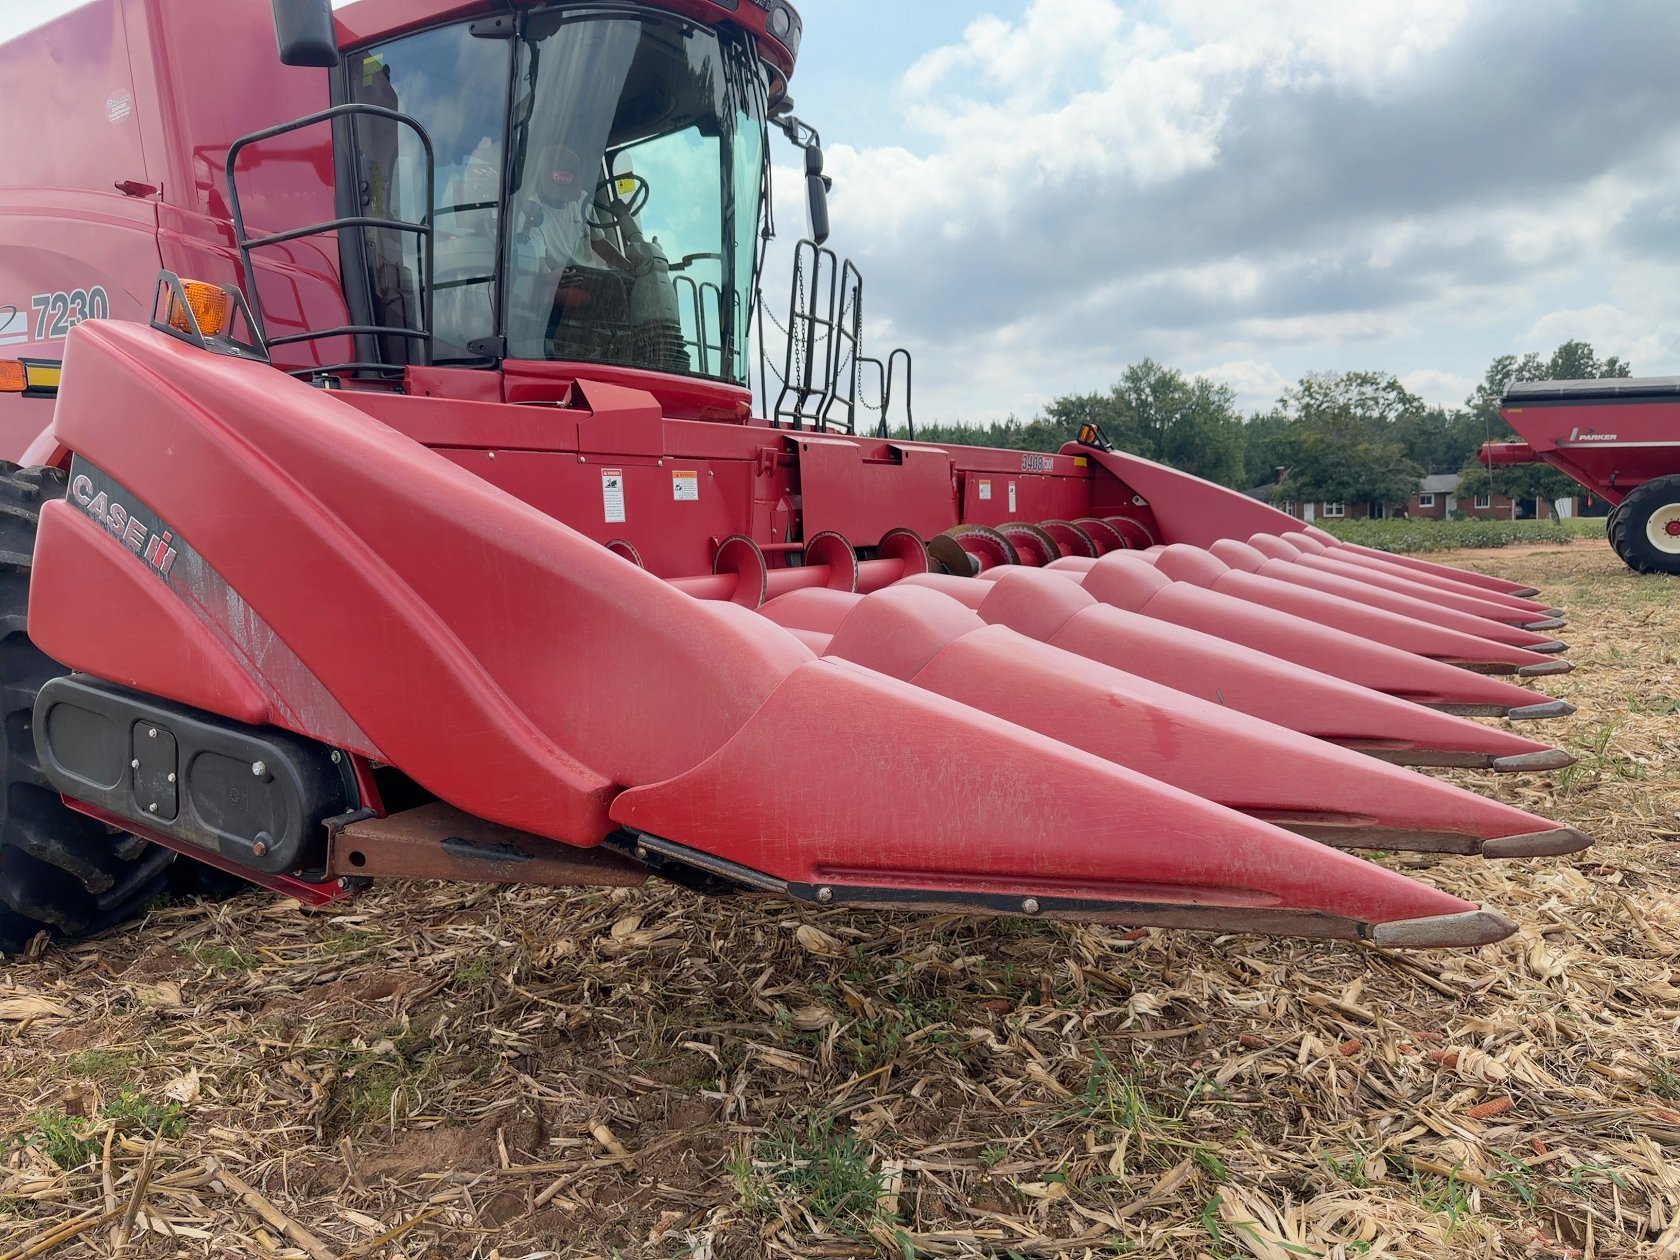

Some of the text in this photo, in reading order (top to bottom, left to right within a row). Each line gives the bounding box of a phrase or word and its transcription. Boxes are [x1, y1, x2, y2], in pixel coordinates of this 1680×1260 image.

[32, 285, 109, 340] 7230
[1021, 454, 1043, 472] 3408
[73, 474, 148, 552] CASE
